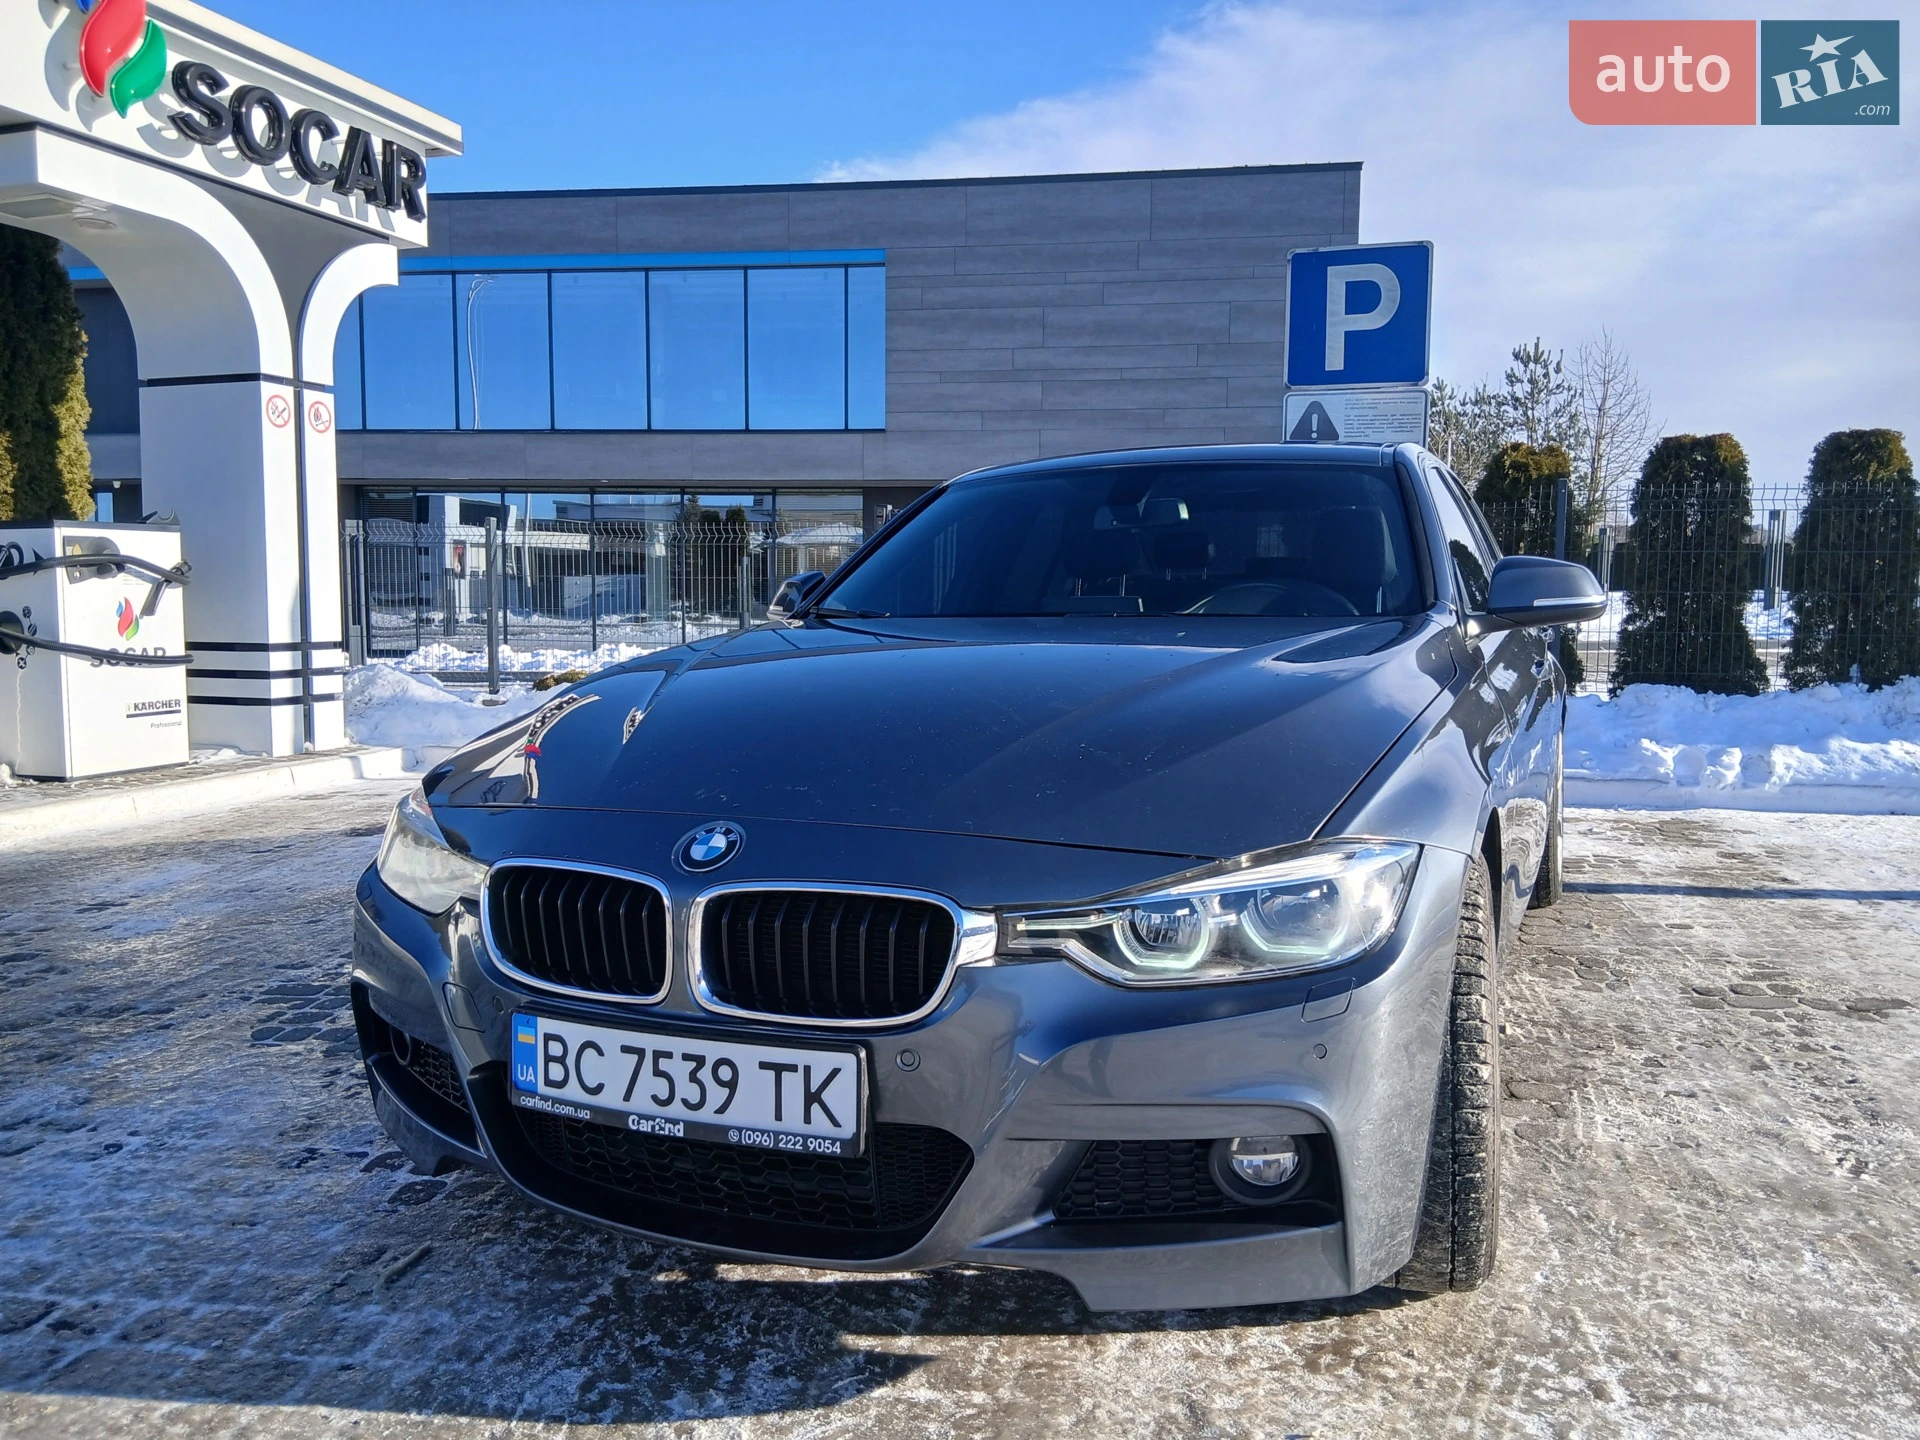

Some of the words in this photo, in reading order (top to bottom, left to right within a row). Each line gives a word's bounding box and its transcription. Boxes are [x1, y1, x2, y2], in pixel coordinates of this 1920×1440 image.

[167, 60, 426, 223] SOCAR
[1325, 263, 1400, 371] P
[518, 1063, 536, 1084] UA
[543, 1032, 606, 1096] BC
[620, 1044, 739, 1115] 7539
[758, 1061, 842, 1128] TK
[520, 1095, 591, 1119] carfind.com.ua
[741, 1129, 774, 1148] (096)
[778, 1135, 803, 1150] 222
[807, 1138, 841, 1154] 9054
